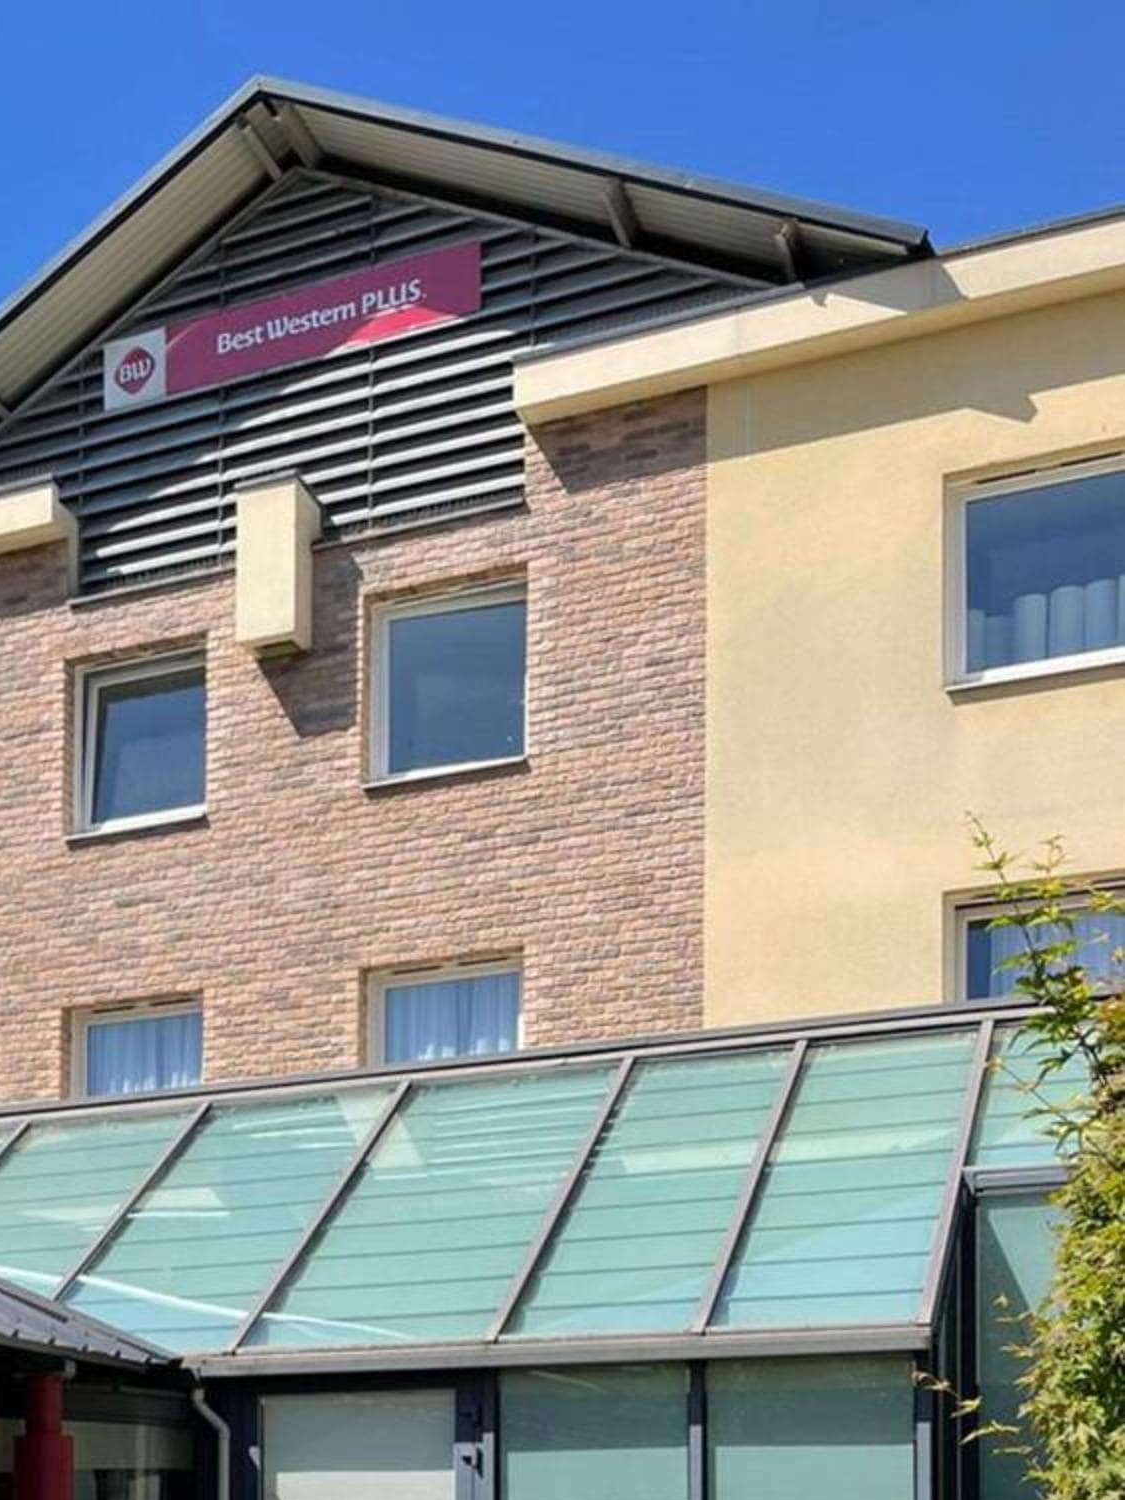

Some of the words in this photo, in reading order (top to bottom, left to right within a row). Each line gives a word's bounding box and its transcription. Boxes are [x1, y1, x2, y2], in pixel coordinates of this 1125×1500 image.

[217, 325, 264, 354] Best
[266, 301, 356, 340] Western
[119, 357, 152, 384] BW
